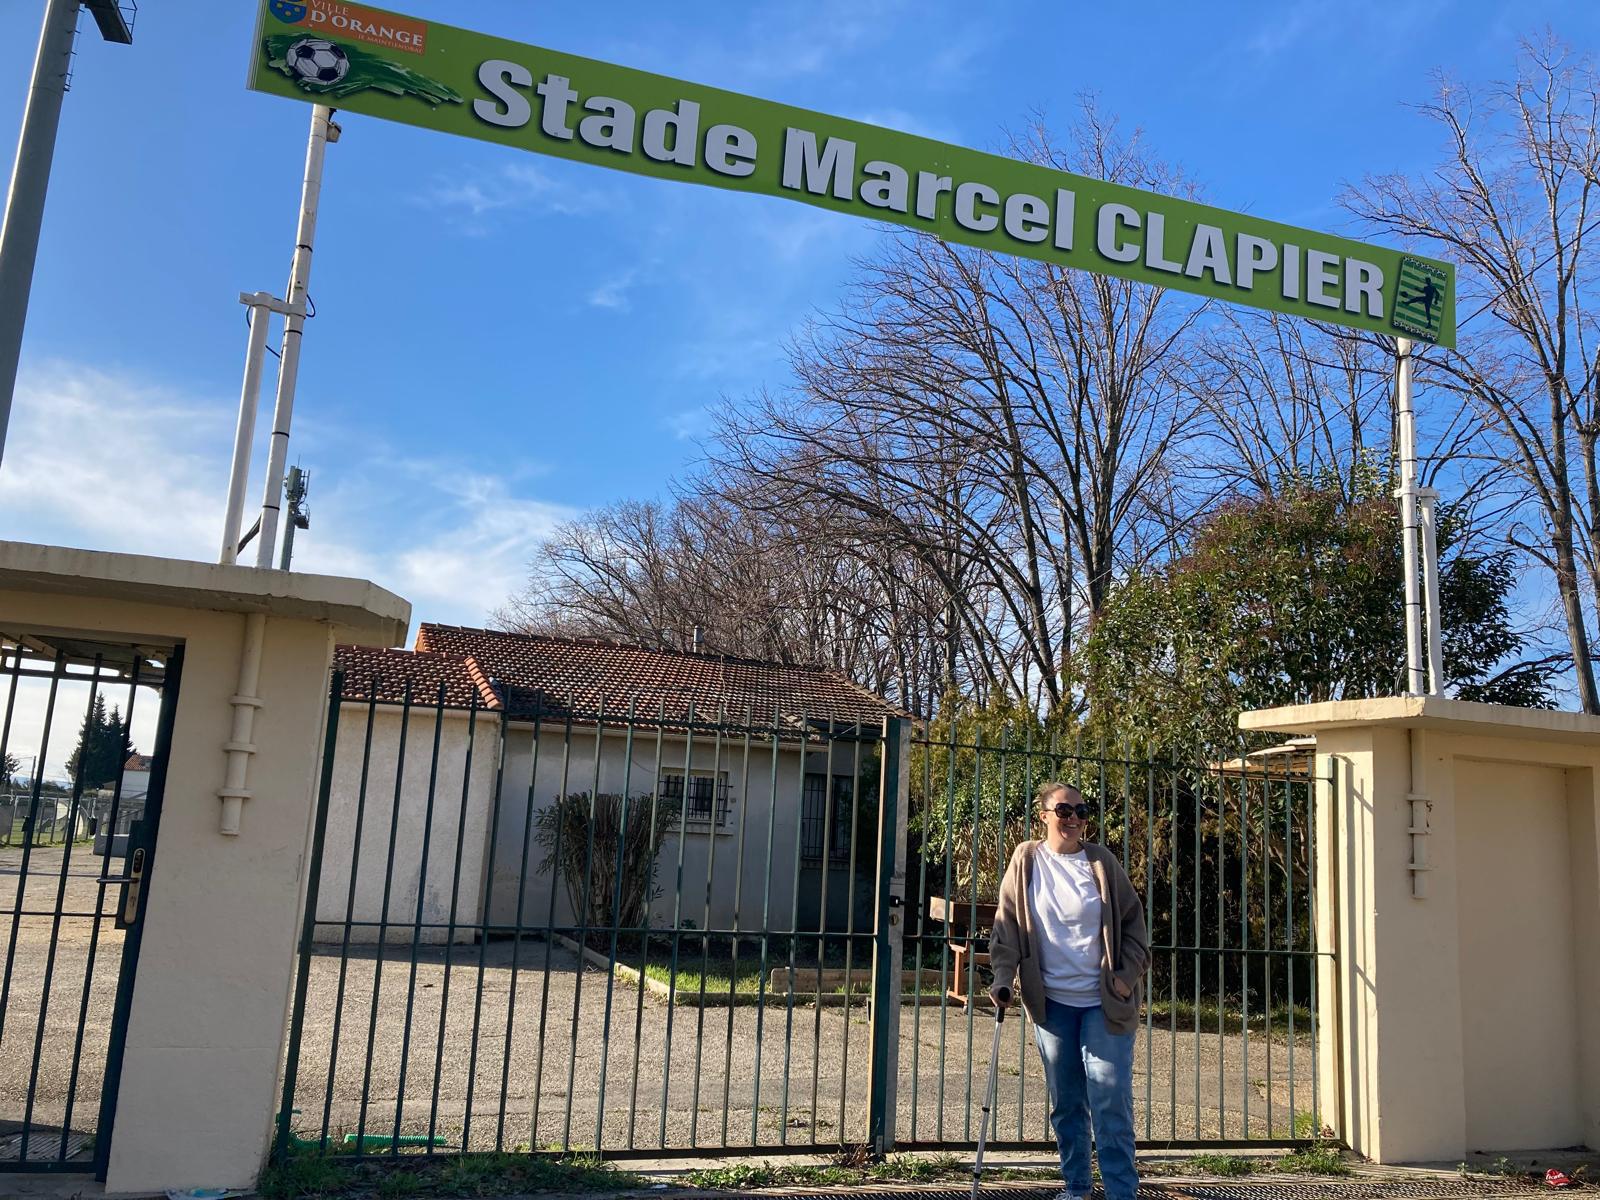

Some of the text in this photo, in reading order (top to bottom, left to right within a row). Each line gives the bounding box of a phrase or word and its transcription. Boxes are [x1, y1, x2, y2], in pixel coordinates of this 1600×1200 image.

[312, 0, 348, 15] VILLE
[311, 10, 423, 46] D'ORANGE
[473, 59, 1385, 318] Stade Marcel CLAPIER
